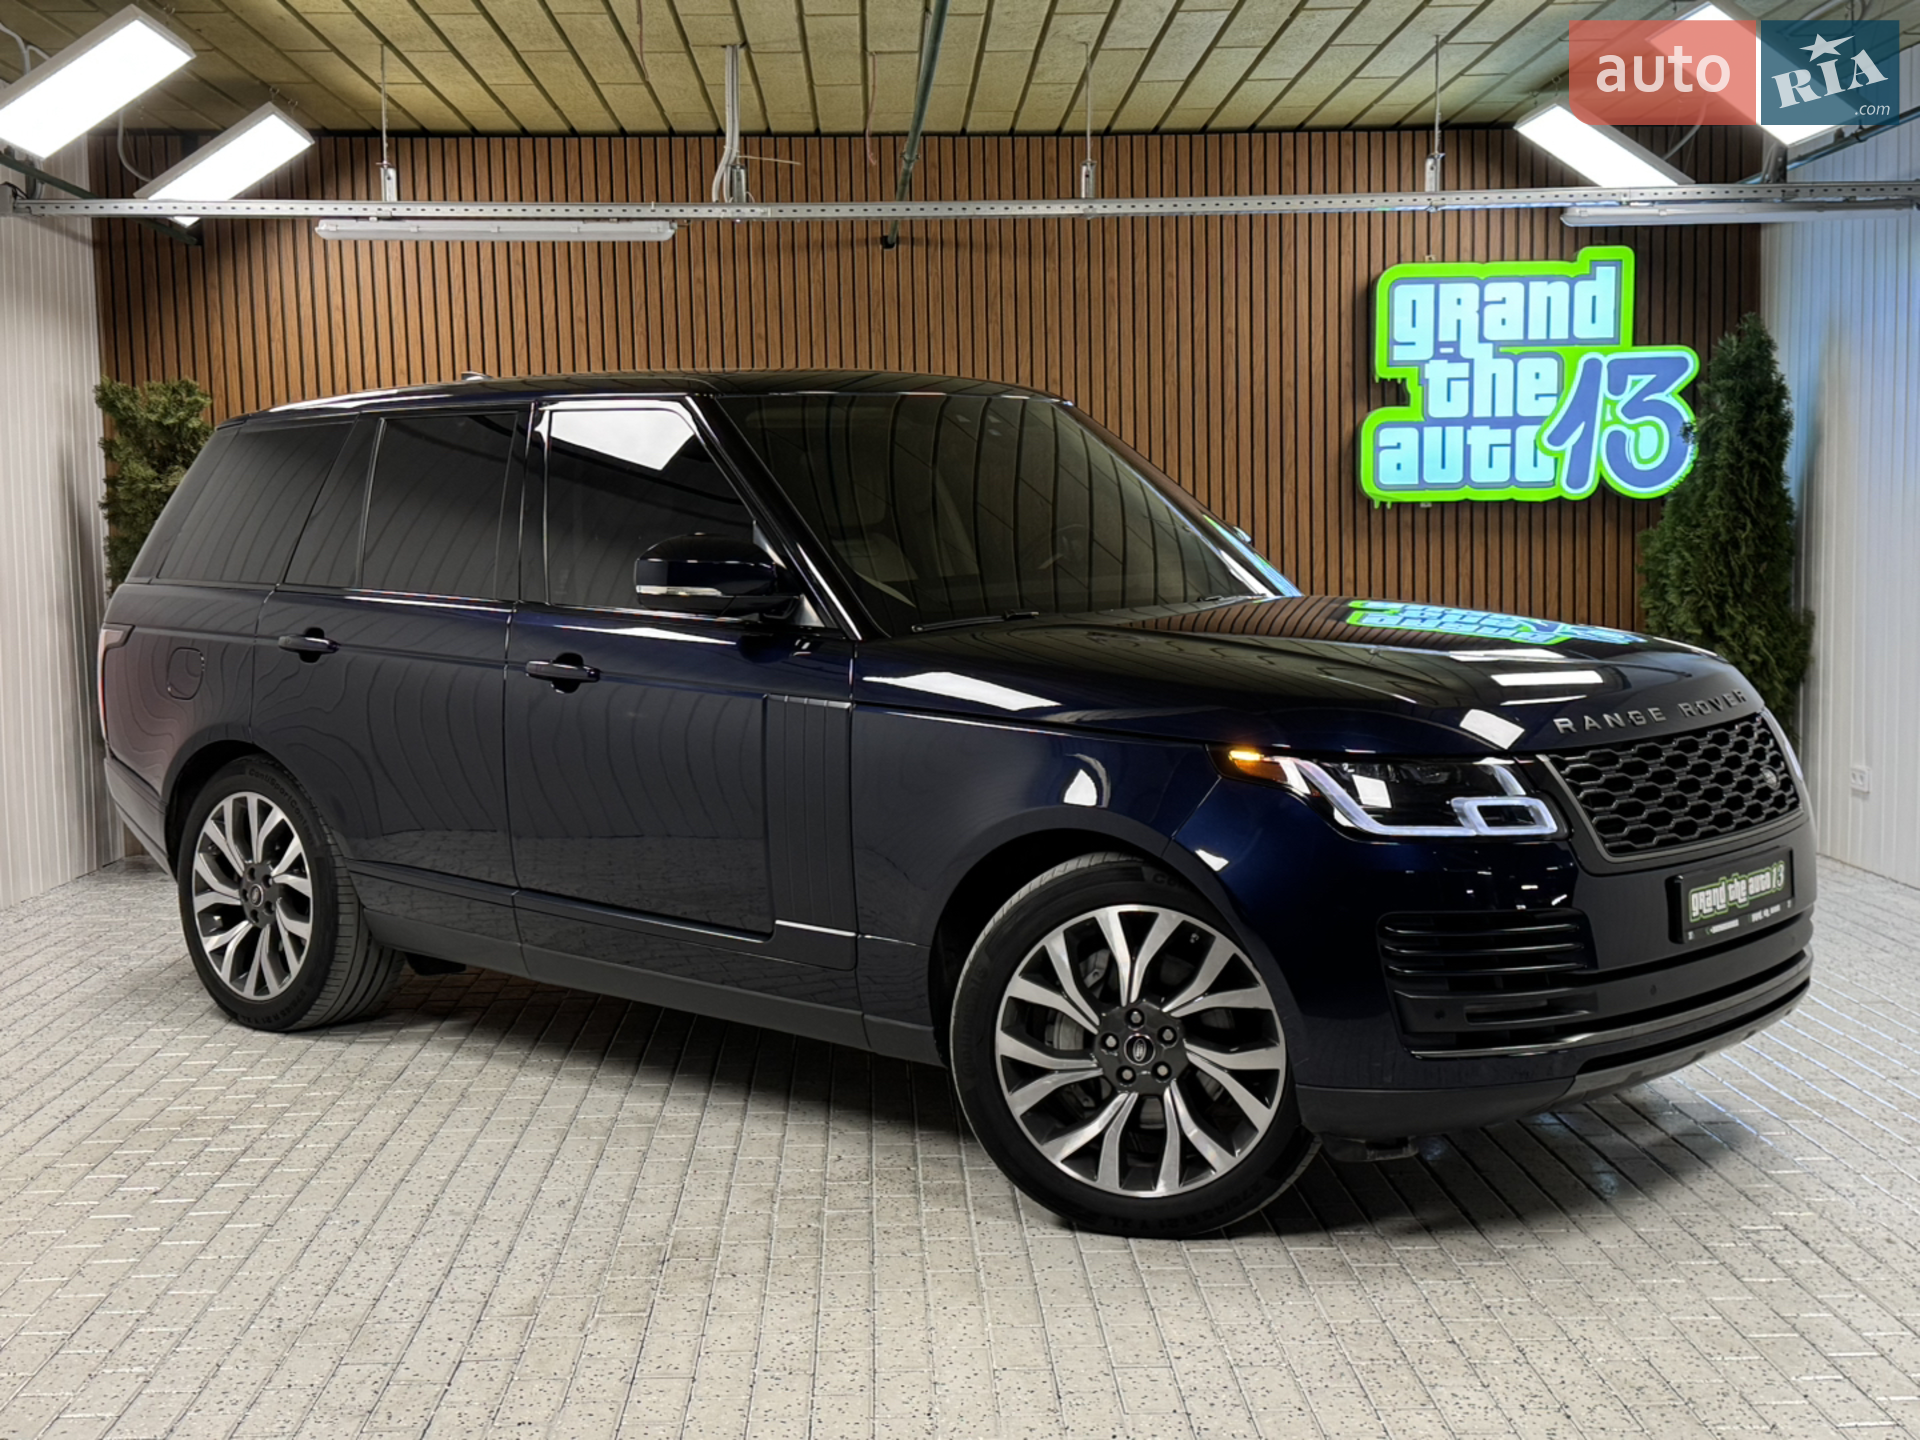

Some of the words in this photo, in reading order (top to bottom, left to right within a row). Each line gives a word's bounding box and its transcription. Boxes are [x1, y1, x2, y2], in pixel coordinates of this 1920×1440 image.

[1391, 265, 1617, 361] grand
[1377, 424, 1557, 485] auto
[1424, 343, 1559, 418] the
[1543, 352, 1695, 494] 13
[1553, 707, 1667, 735] RANGE
[1677, 688, 1748, 718] ROVER
